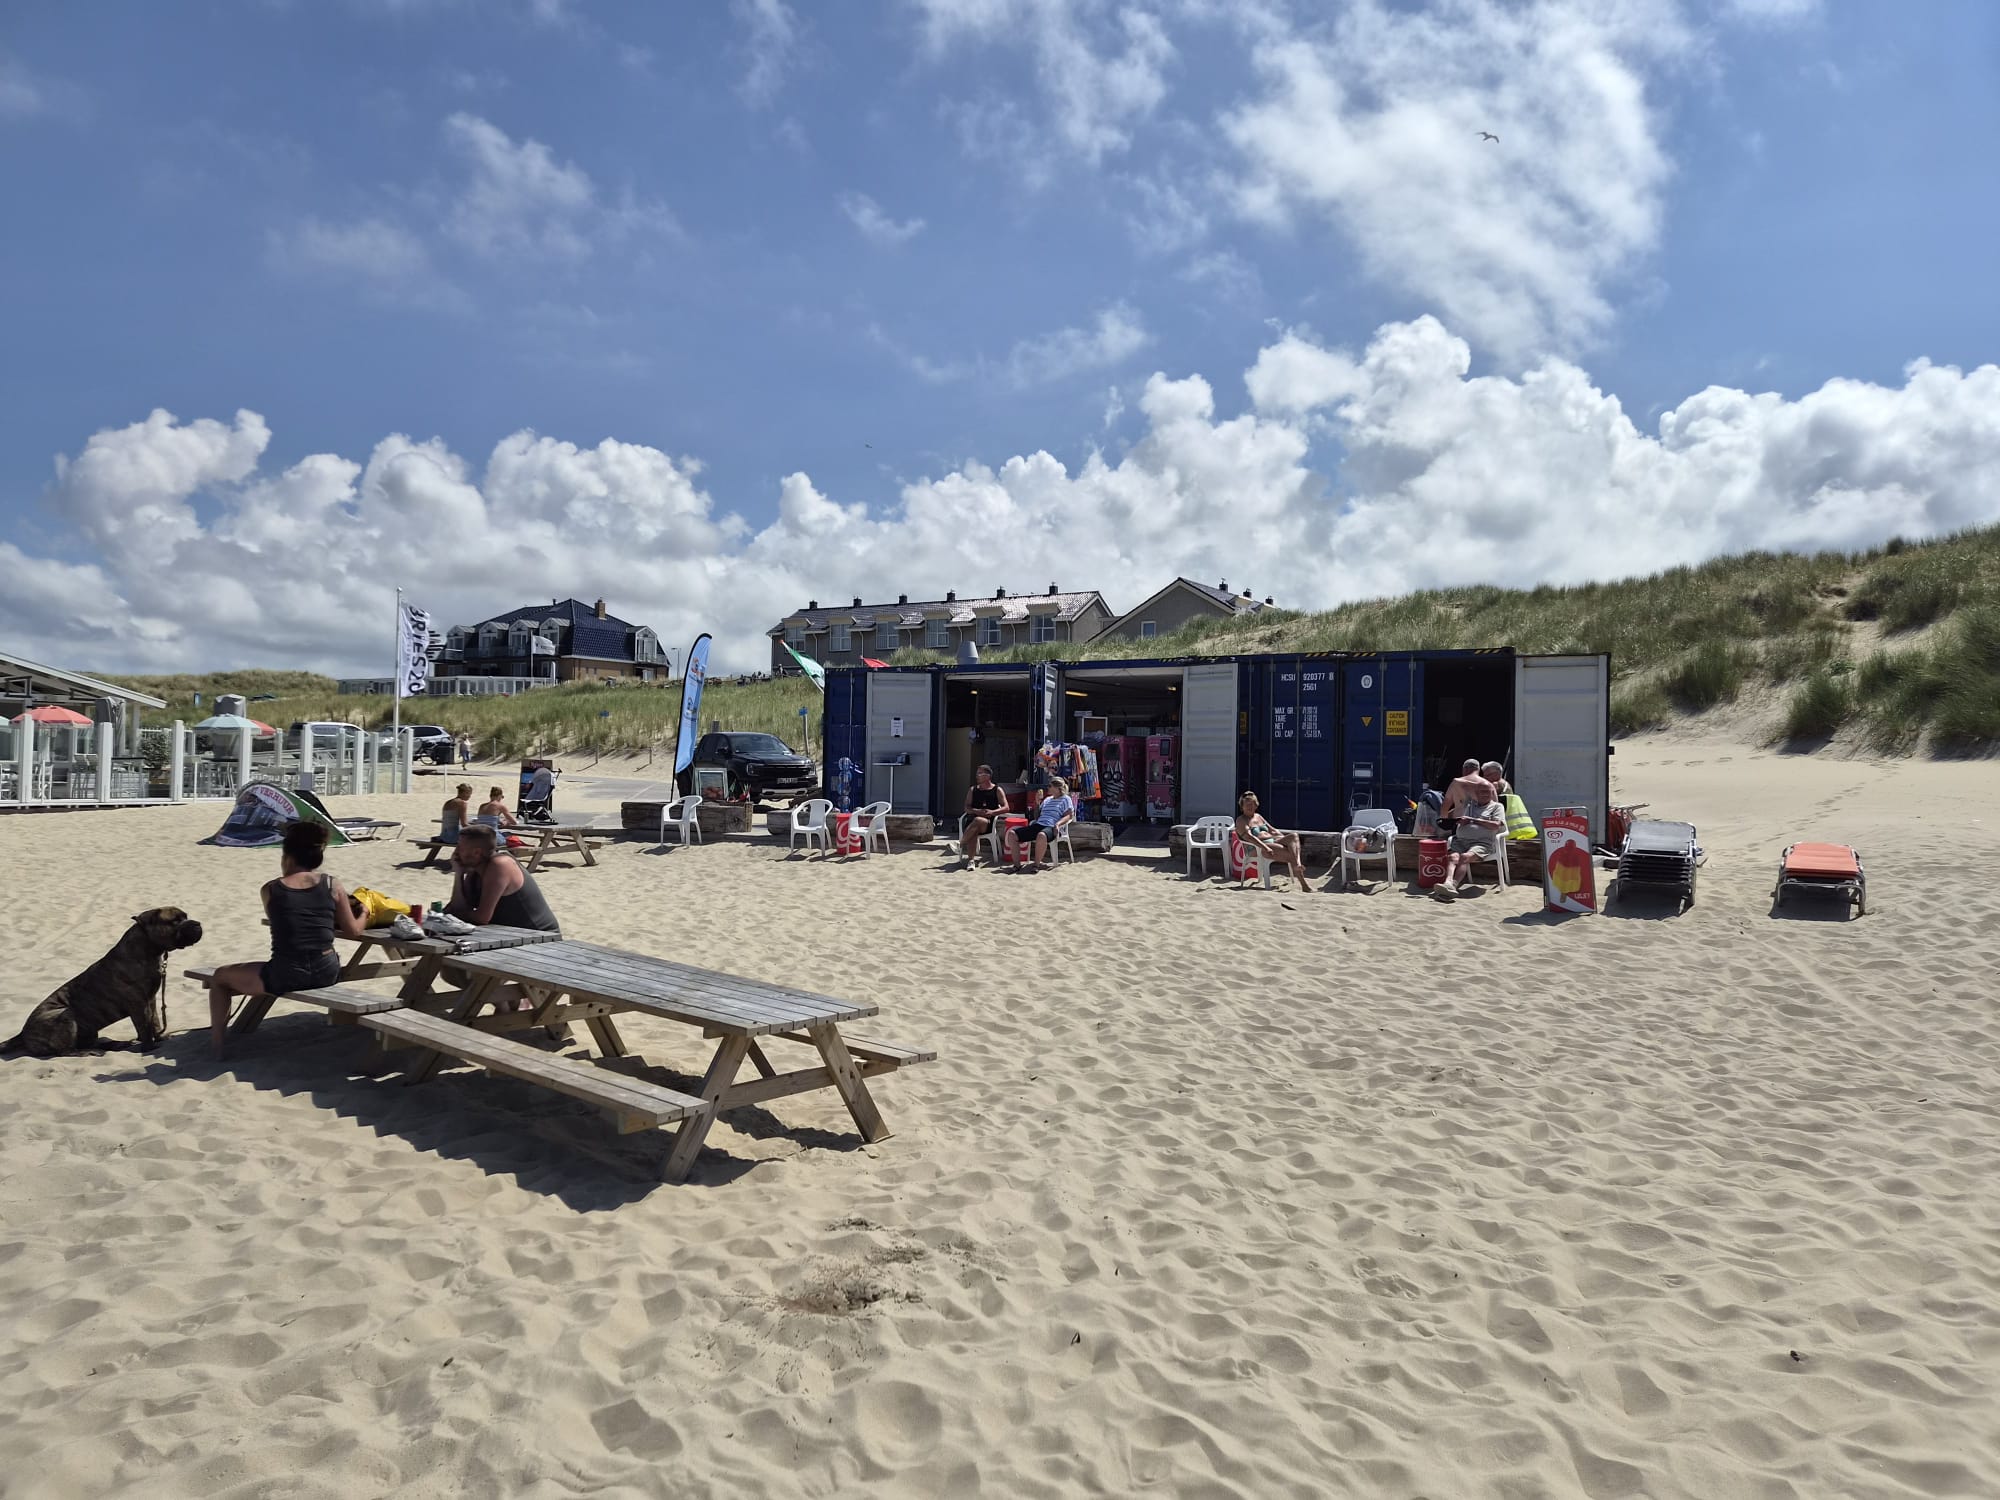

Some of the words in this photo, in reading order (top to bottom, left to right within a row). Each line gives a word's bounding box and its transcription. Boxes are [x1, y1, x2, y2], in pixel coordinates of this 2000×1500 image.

[1281, 673, 1296, 681] HCSU
[1303, 672, 1326, 681] 920377
[1303, 683, 1317, 691] 25G1
[260, 786, 295, 815] VERHUUR
